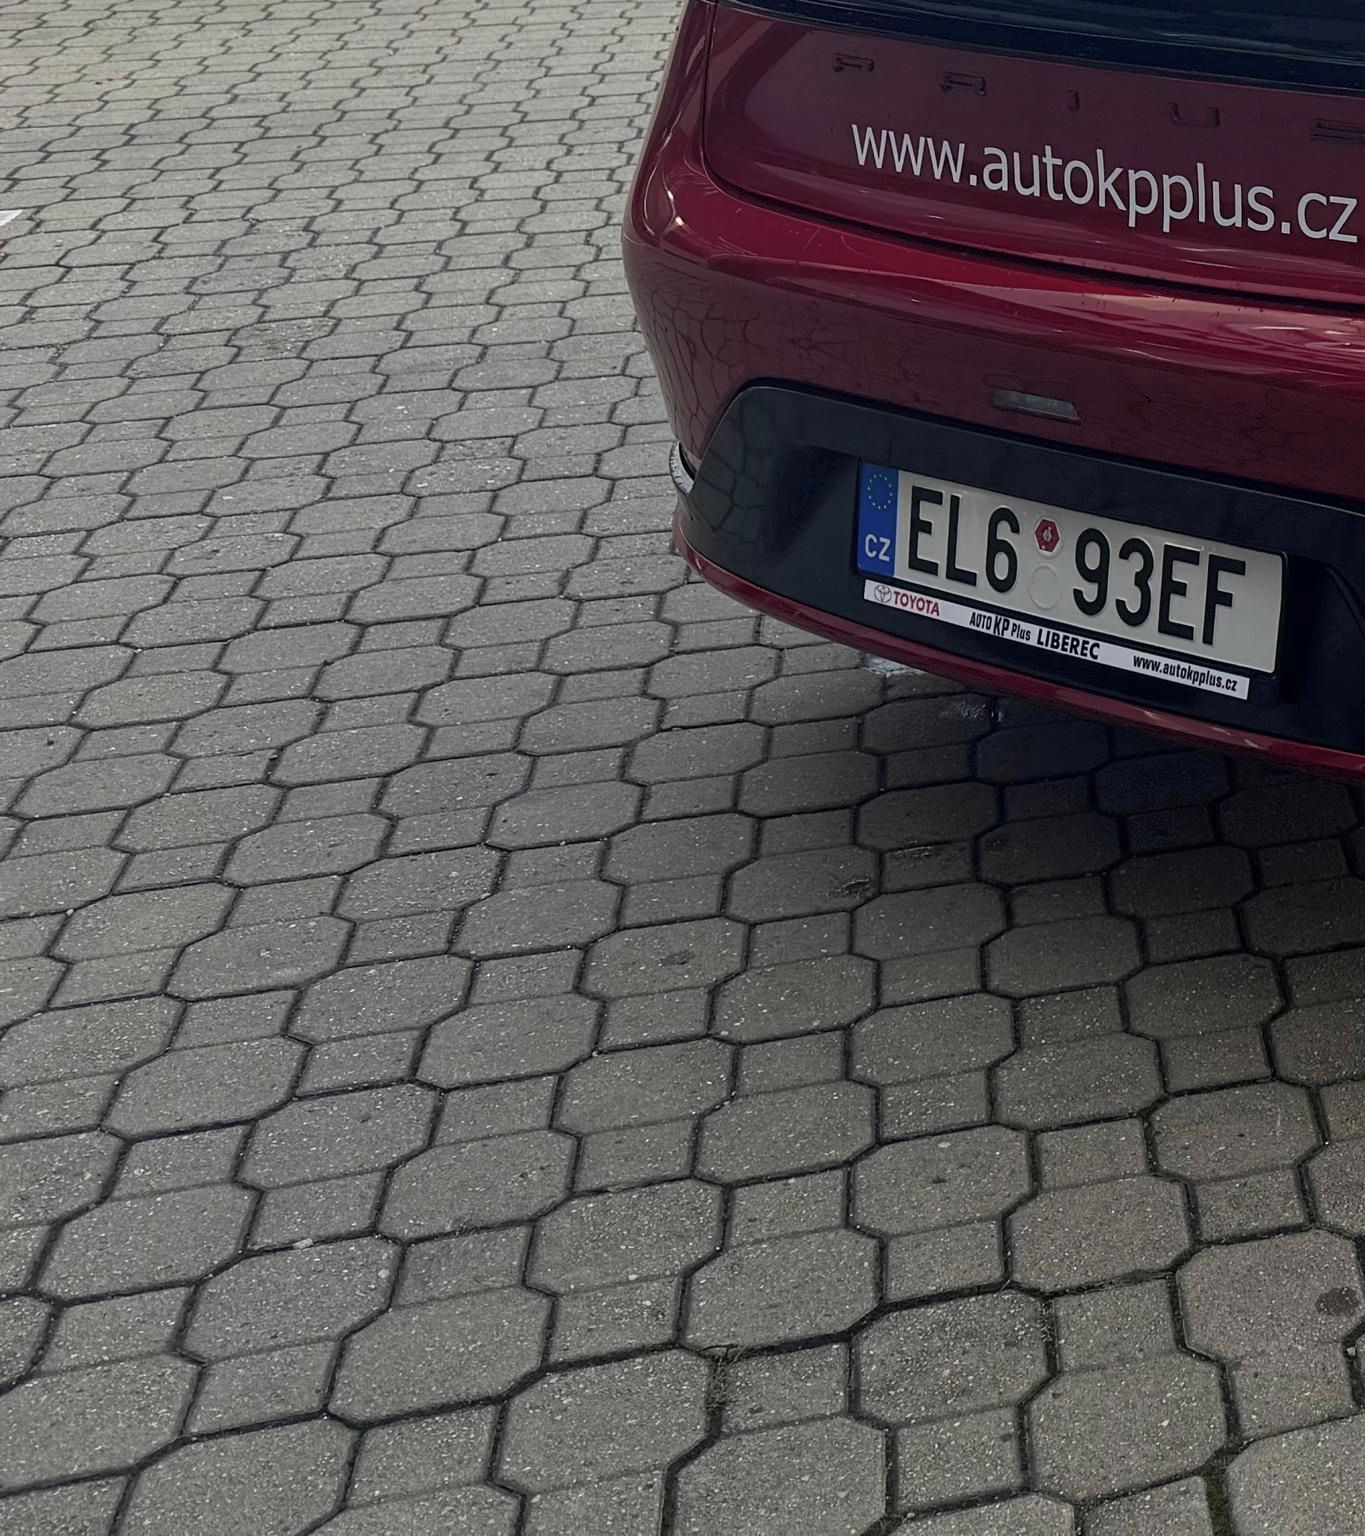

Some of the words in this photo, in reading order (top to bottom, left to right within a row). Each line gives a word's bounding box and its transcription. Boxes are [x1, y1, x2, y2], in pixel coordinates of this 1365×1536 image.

[851, 123, 1358, 244] www.autokpplus.cz
[864, 534, 891, 562] CZ
[907, 485, 1021, 594] EL6
[1072, 528, 1247, 646] 93EF
[894, 590, 940, 617] TOYOTA
[970, 612, 992, 631] AUTO
[993, 616, 1010, 637] KP
[1011, 623, 1031, 642] Plus
[1037, 628, 1100, 661] LIBEREC
[1133, 655, 1238, 693] www.autokpplus.cz
